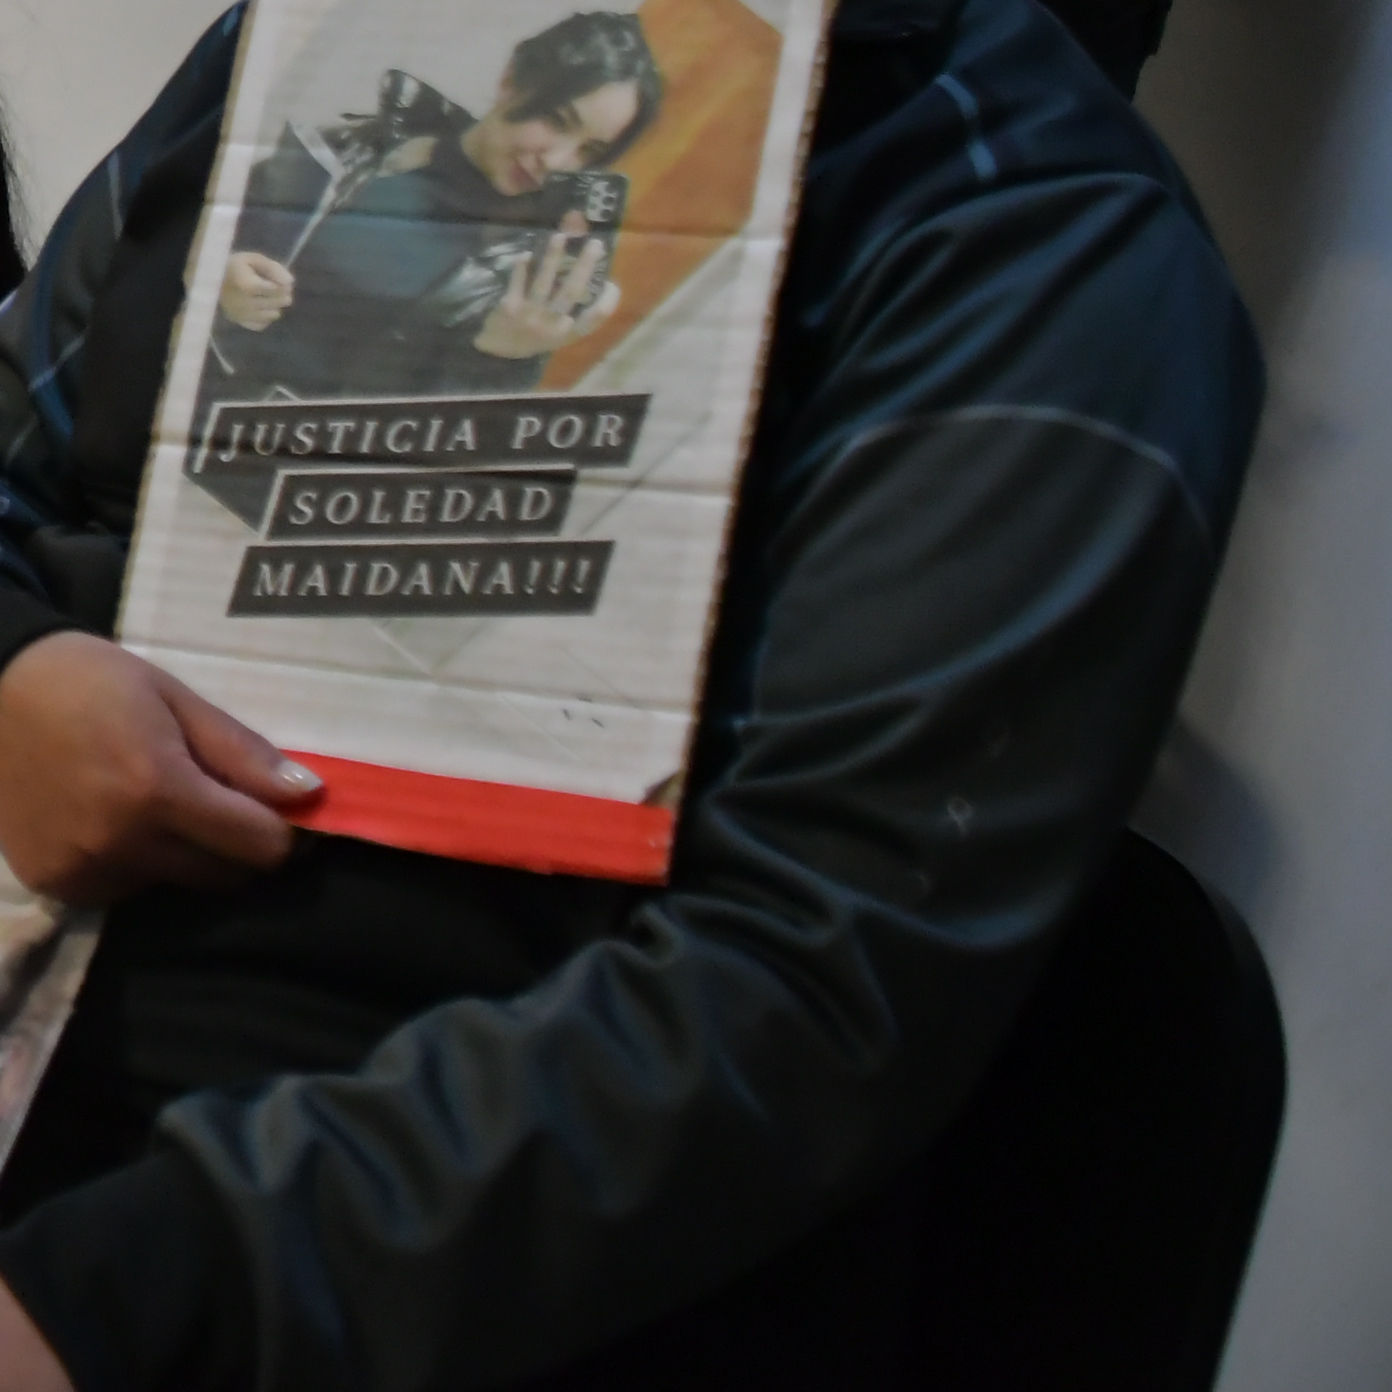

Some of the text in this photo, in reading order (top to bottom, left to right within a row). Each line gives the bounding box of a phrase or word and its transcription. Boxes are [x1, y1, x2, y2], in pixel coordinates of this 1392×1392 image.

[219, 411, 626, 462] JUSTICIA POR
[289, 486, 554, 526] SOLEDAD
[251, 557, 592, 597] MAIDANA!!!
